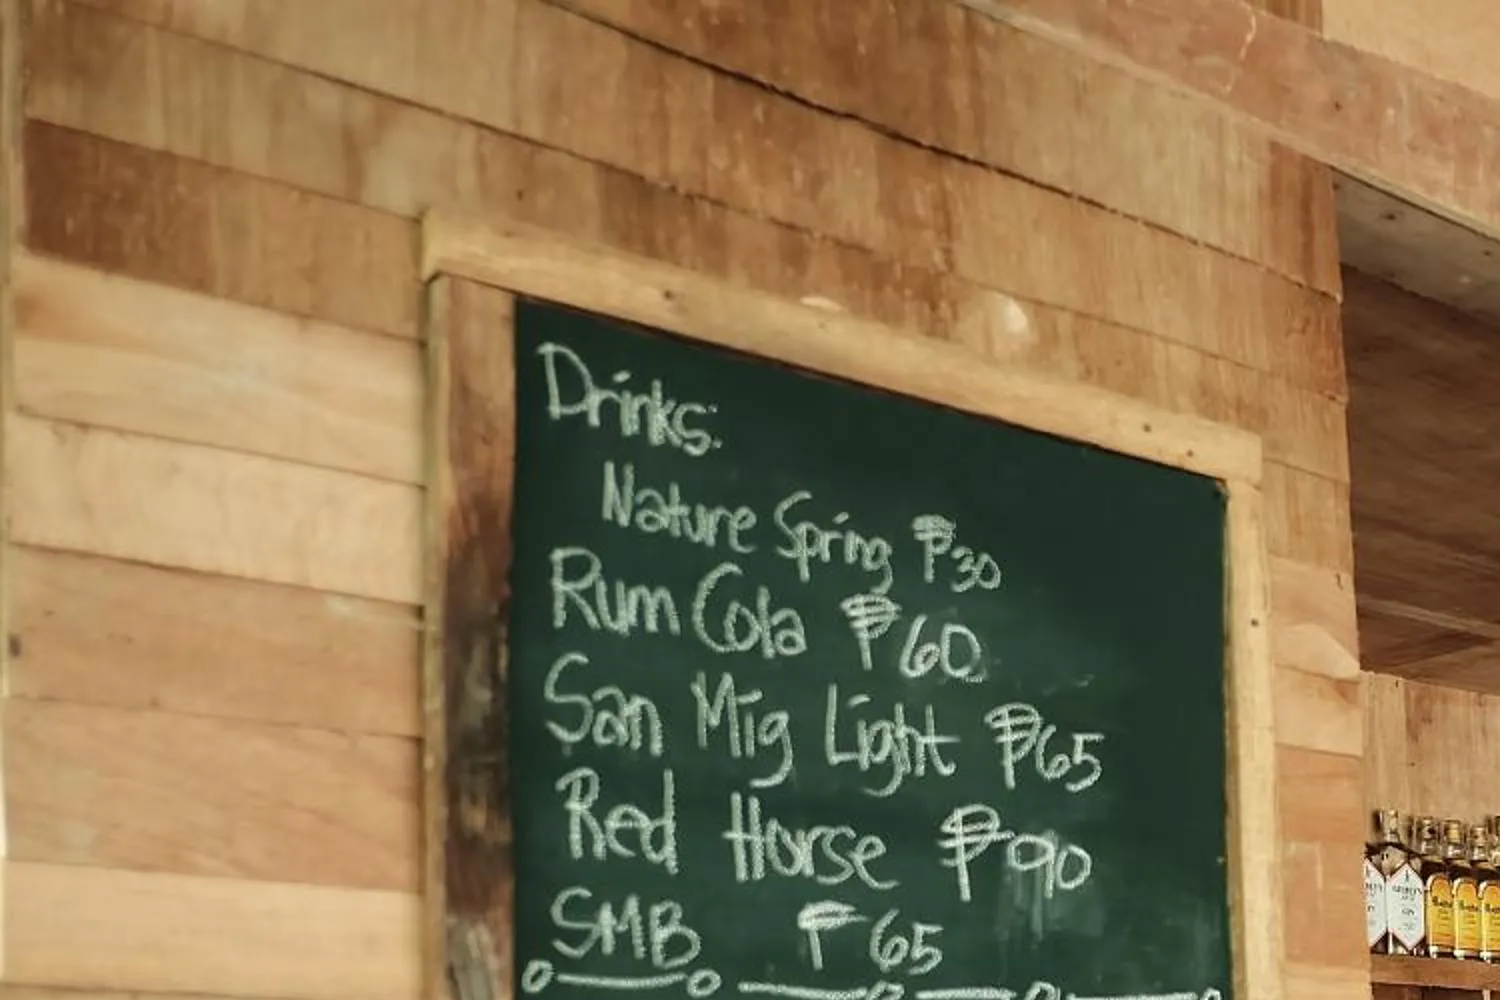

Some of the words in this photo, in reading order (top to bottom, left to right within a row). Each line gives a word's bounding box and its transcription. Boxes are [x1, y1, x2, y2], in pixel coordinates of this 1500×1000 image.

[602, 461, 758, 553] Nature
[774, 490, 892, 596] Spring
[549, 547, 680, 635] Rum
[692, 563, 807, 659] Cola
[544, 652, 662, 757] San
[692, 672, 793, 788] Mig
[825, 682, 960, 797] Light
[556, 767, 678, 875] Red
[722, 792, 901, 890] Horse
[550, 886, 701, 968] SMB
